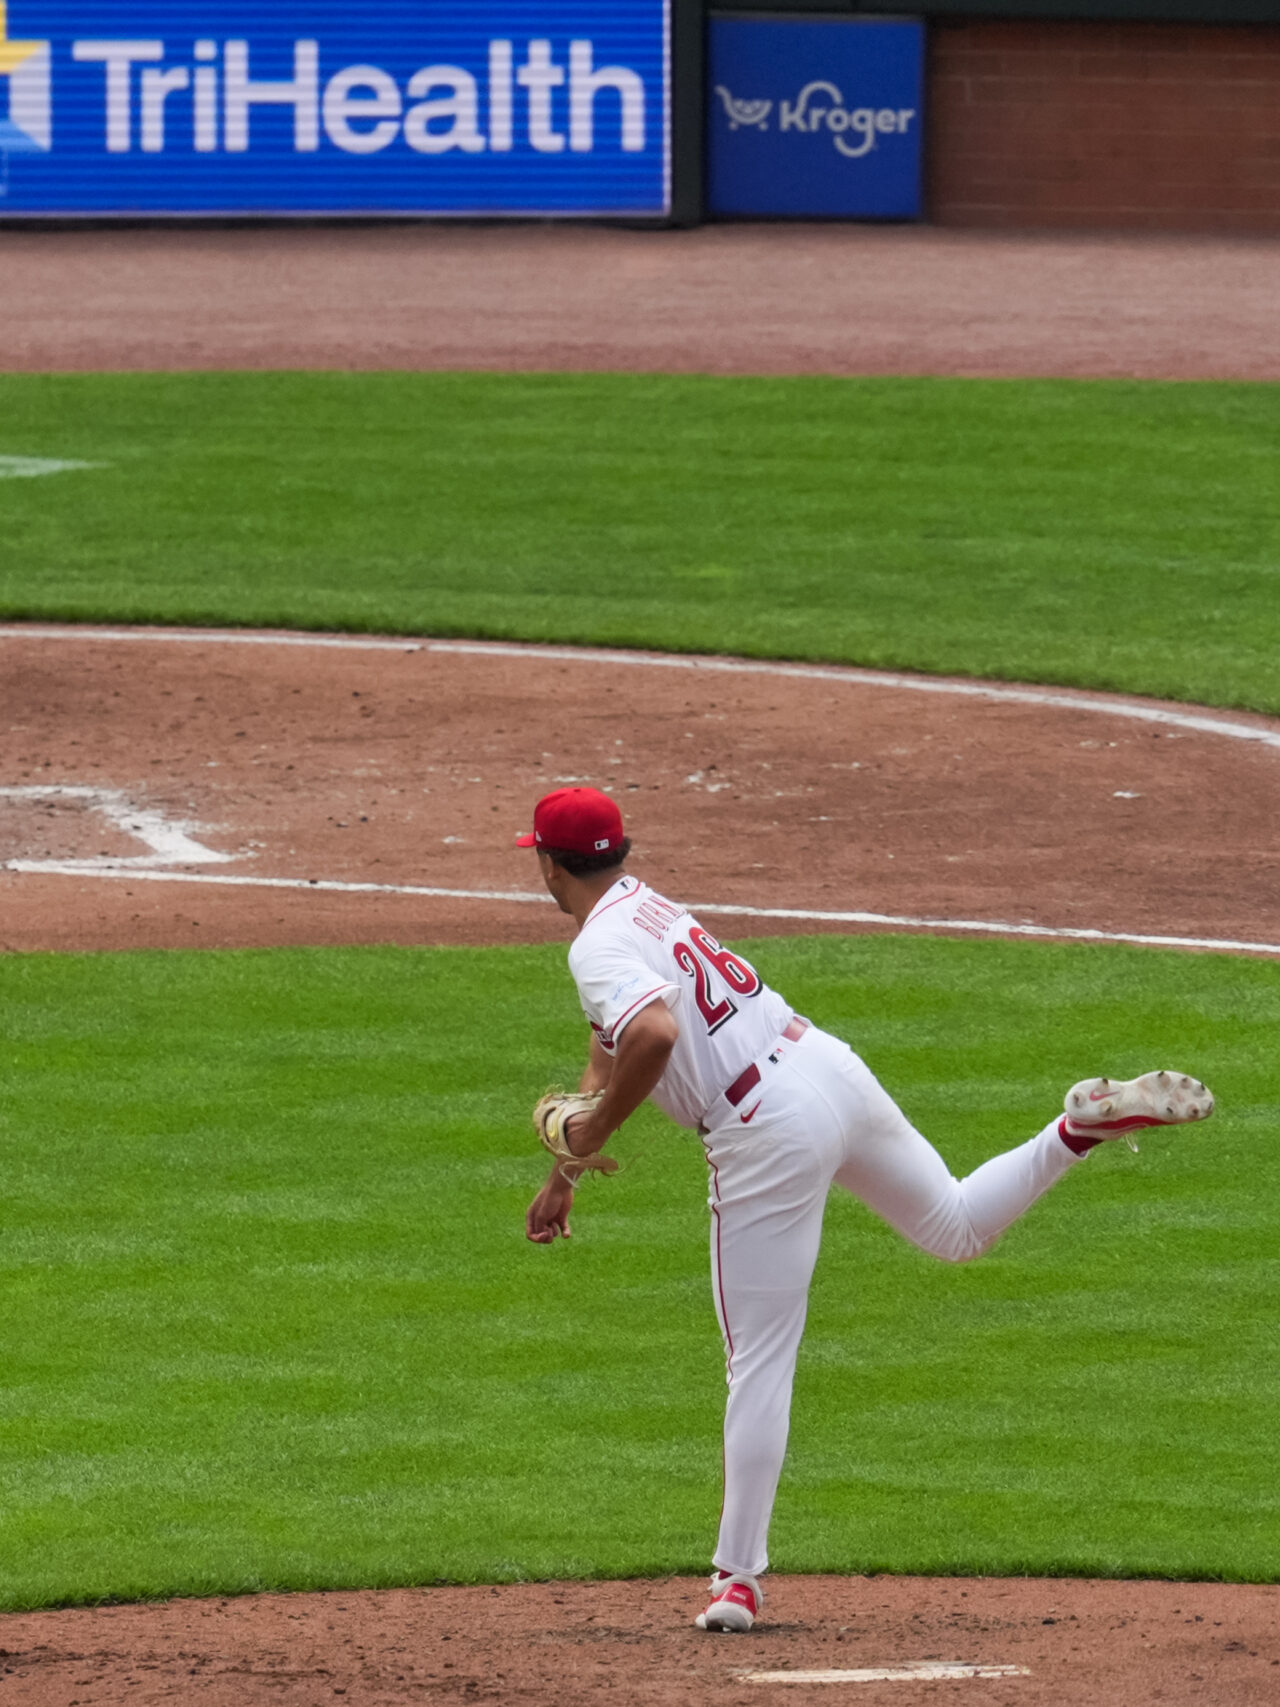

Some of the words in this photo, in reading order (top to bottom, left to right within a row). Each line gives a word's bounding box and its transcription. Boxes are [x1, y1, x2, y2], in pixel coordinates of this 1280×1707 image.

[72, 39, 645, 154] TriHealth
[779, 81, 915, 157] Kroger
[672, 926, 764, 1037] 26
